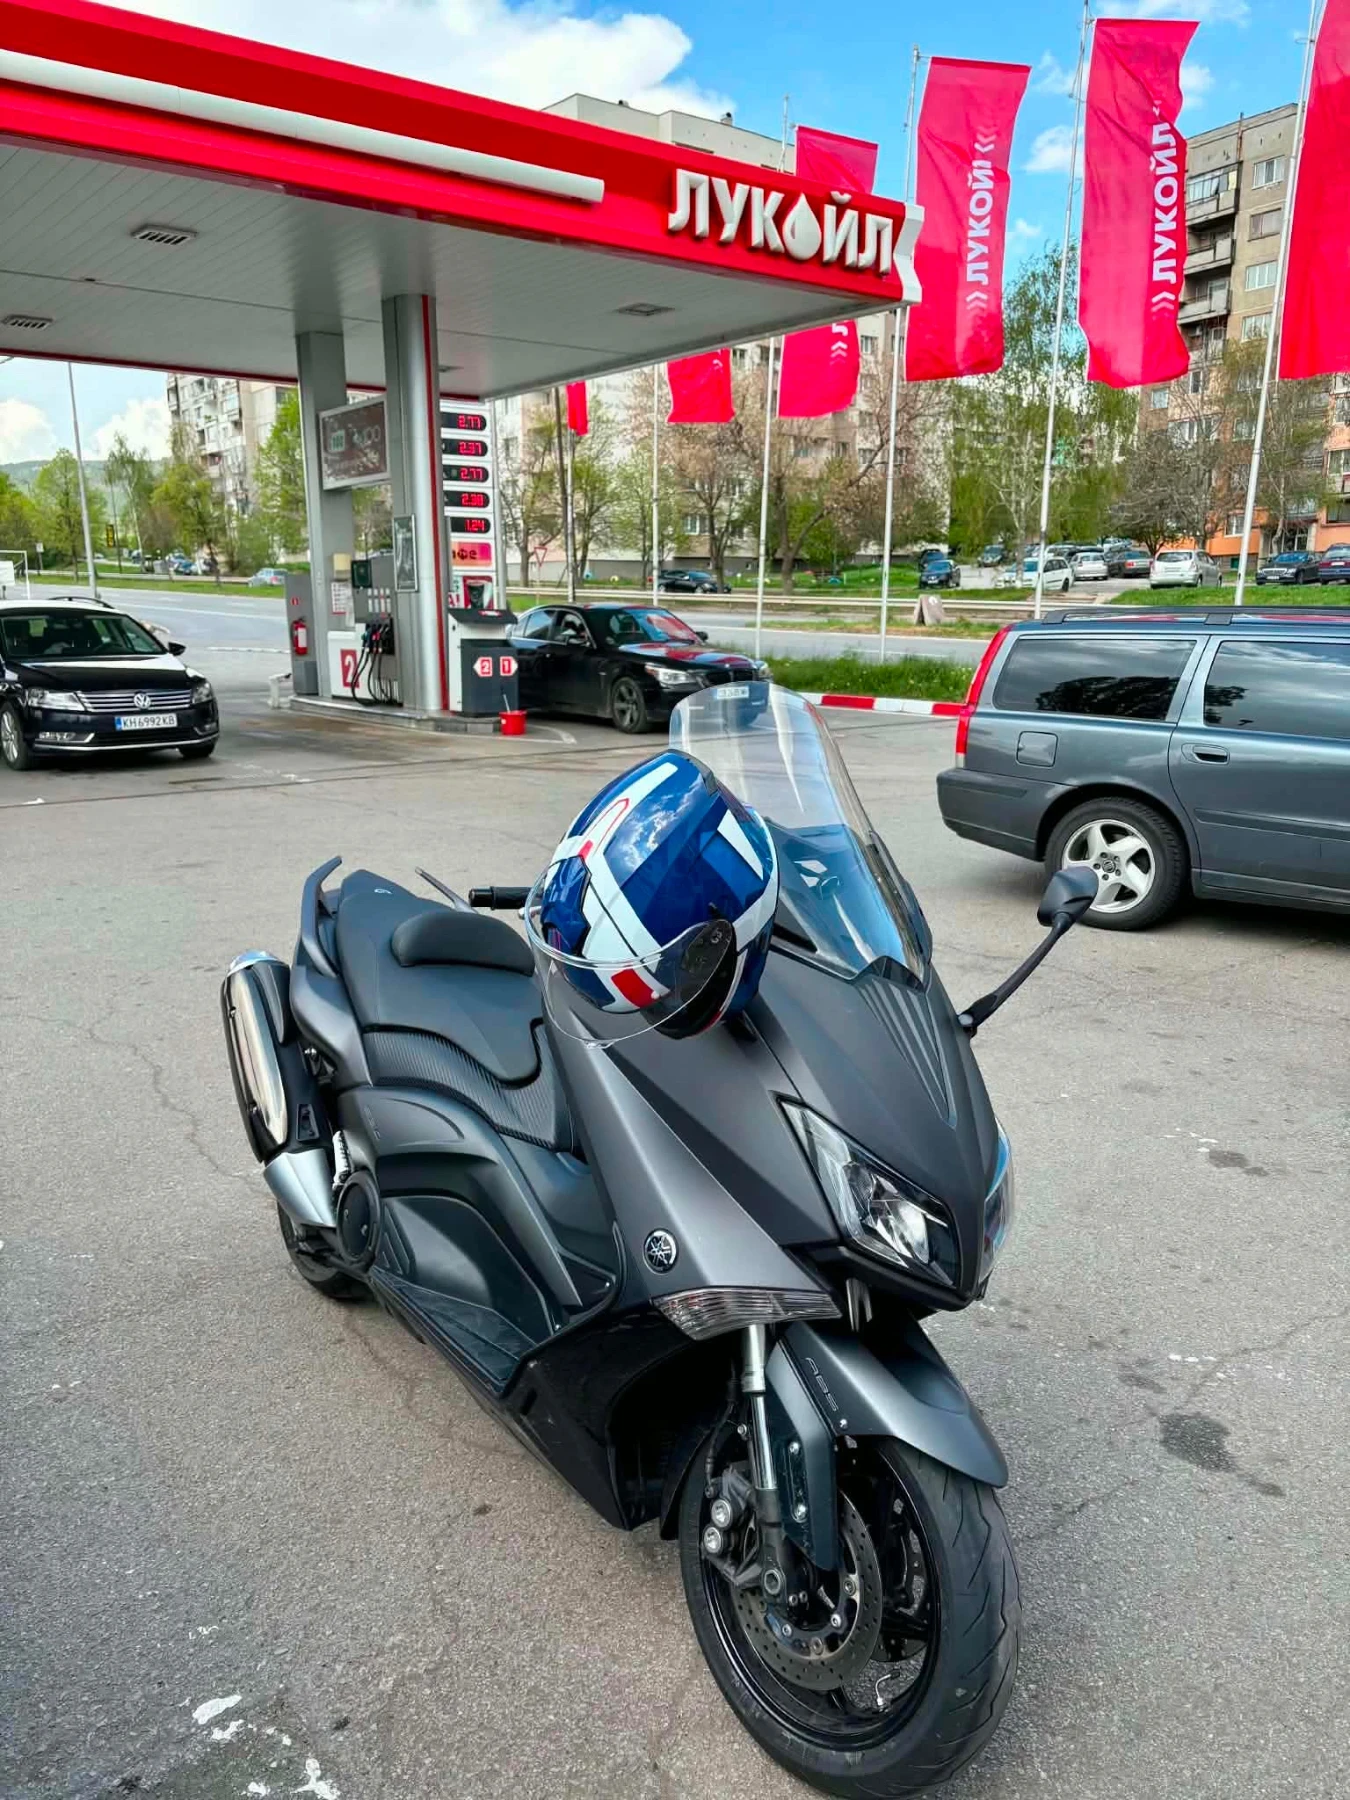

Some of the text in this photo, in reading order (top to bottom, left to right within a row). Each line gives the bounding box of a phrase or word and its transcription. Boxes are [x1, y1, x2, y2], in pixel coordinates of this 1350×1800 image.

[1149, 122, 1179, 285] ЛУКОЙЛ
[344, 654, 356, 683] 2
[482, 659, 490, 673] 2
[503, 659, 510, 673] 1
[805, 1357, 839, 1411] ABS
